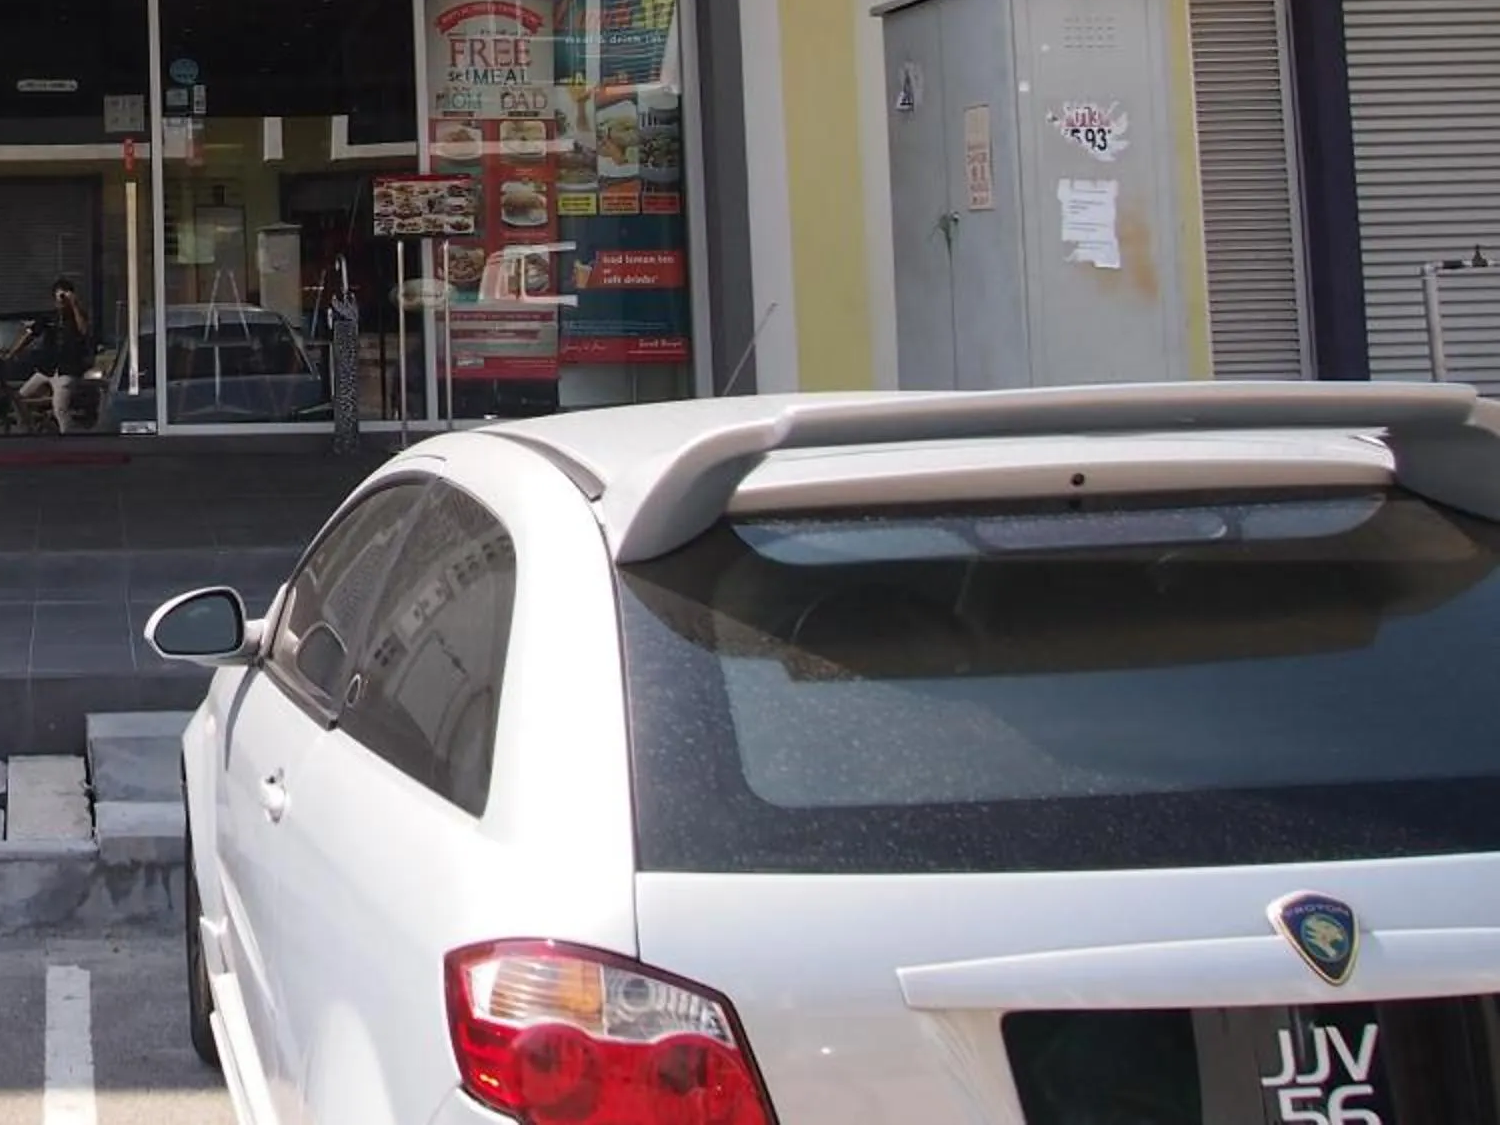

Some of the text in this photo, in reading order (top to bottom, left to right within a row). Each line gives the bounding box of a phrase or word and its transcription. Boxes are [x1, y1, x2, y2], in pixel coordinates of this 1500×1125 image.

[449, 38, 532, 68] FREE
[472, 68, 531, 86] MEAL
[1261, 1023, 1378, 1087] JJV
